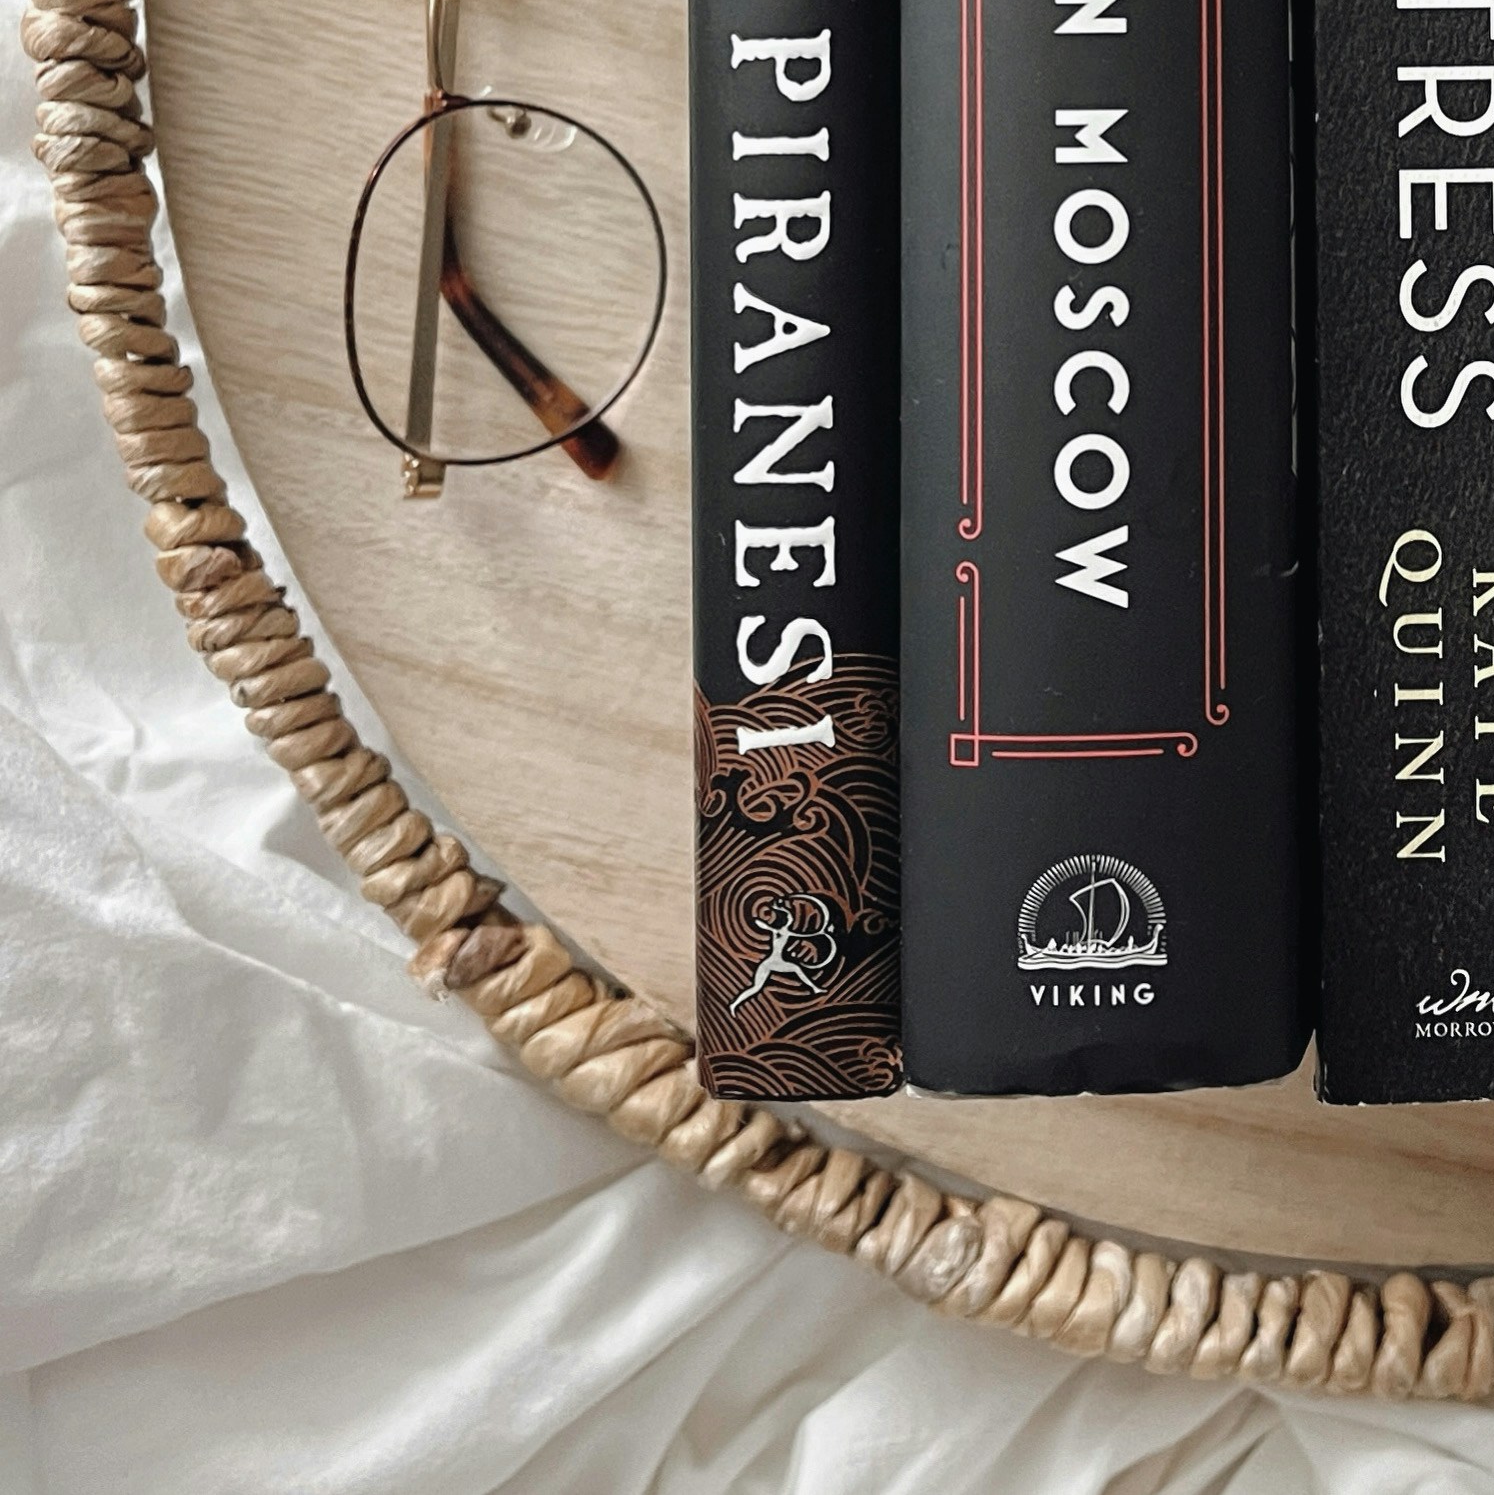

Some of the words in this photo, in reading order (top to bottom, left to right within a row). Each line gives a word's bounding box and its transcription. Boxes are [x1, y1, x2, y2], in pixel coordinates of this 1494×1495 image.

[730, 28, 836, 755] PIRANESI
[1053, 108, 1130, 609] MOSCOW
[1378, 529, 1446, 863] QUINN
[1030, 982, 1157, 1007] VIKING
